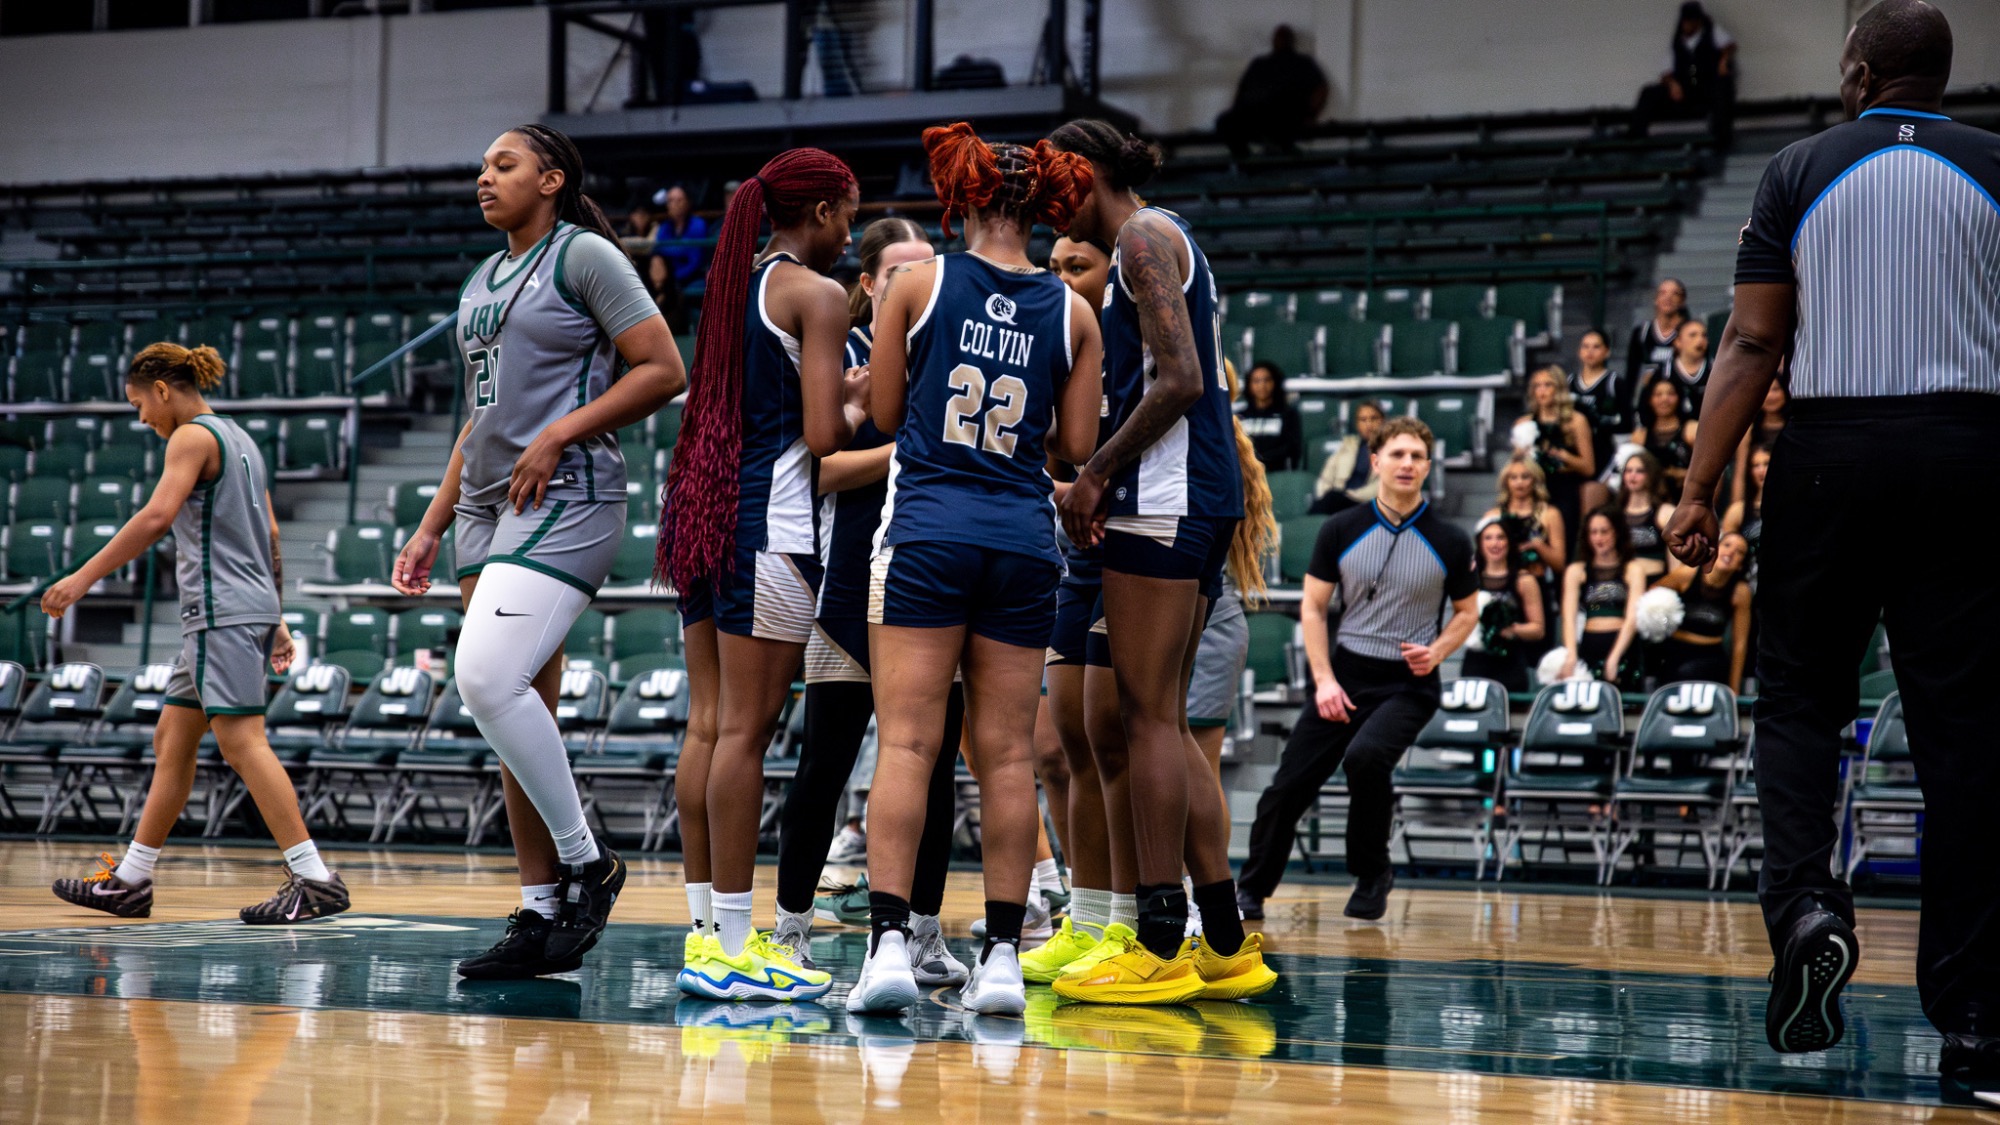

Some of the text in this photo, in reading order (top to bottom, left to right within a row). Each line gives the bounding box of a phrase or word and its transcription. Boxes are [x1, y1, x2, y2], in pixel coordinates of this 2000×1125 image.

[463, 300, 507, 341] JAX
[960, 318, 1034, 367] COLVIN
[467, 345, 500, 410] 21
[943, 363, 1028, 458] 22
[52, 664, 91, 690] JU
[135, 665, 174, 692] JU
[296, 666, 336, 692] JU
[381, 667, 421, 695] JU
[640, 670, 681, 698] JU
[1442, 680, 1490, 709] JU
[1553, 681, 1600, 711] JU
[1667, 684, 1717, 713] JU
